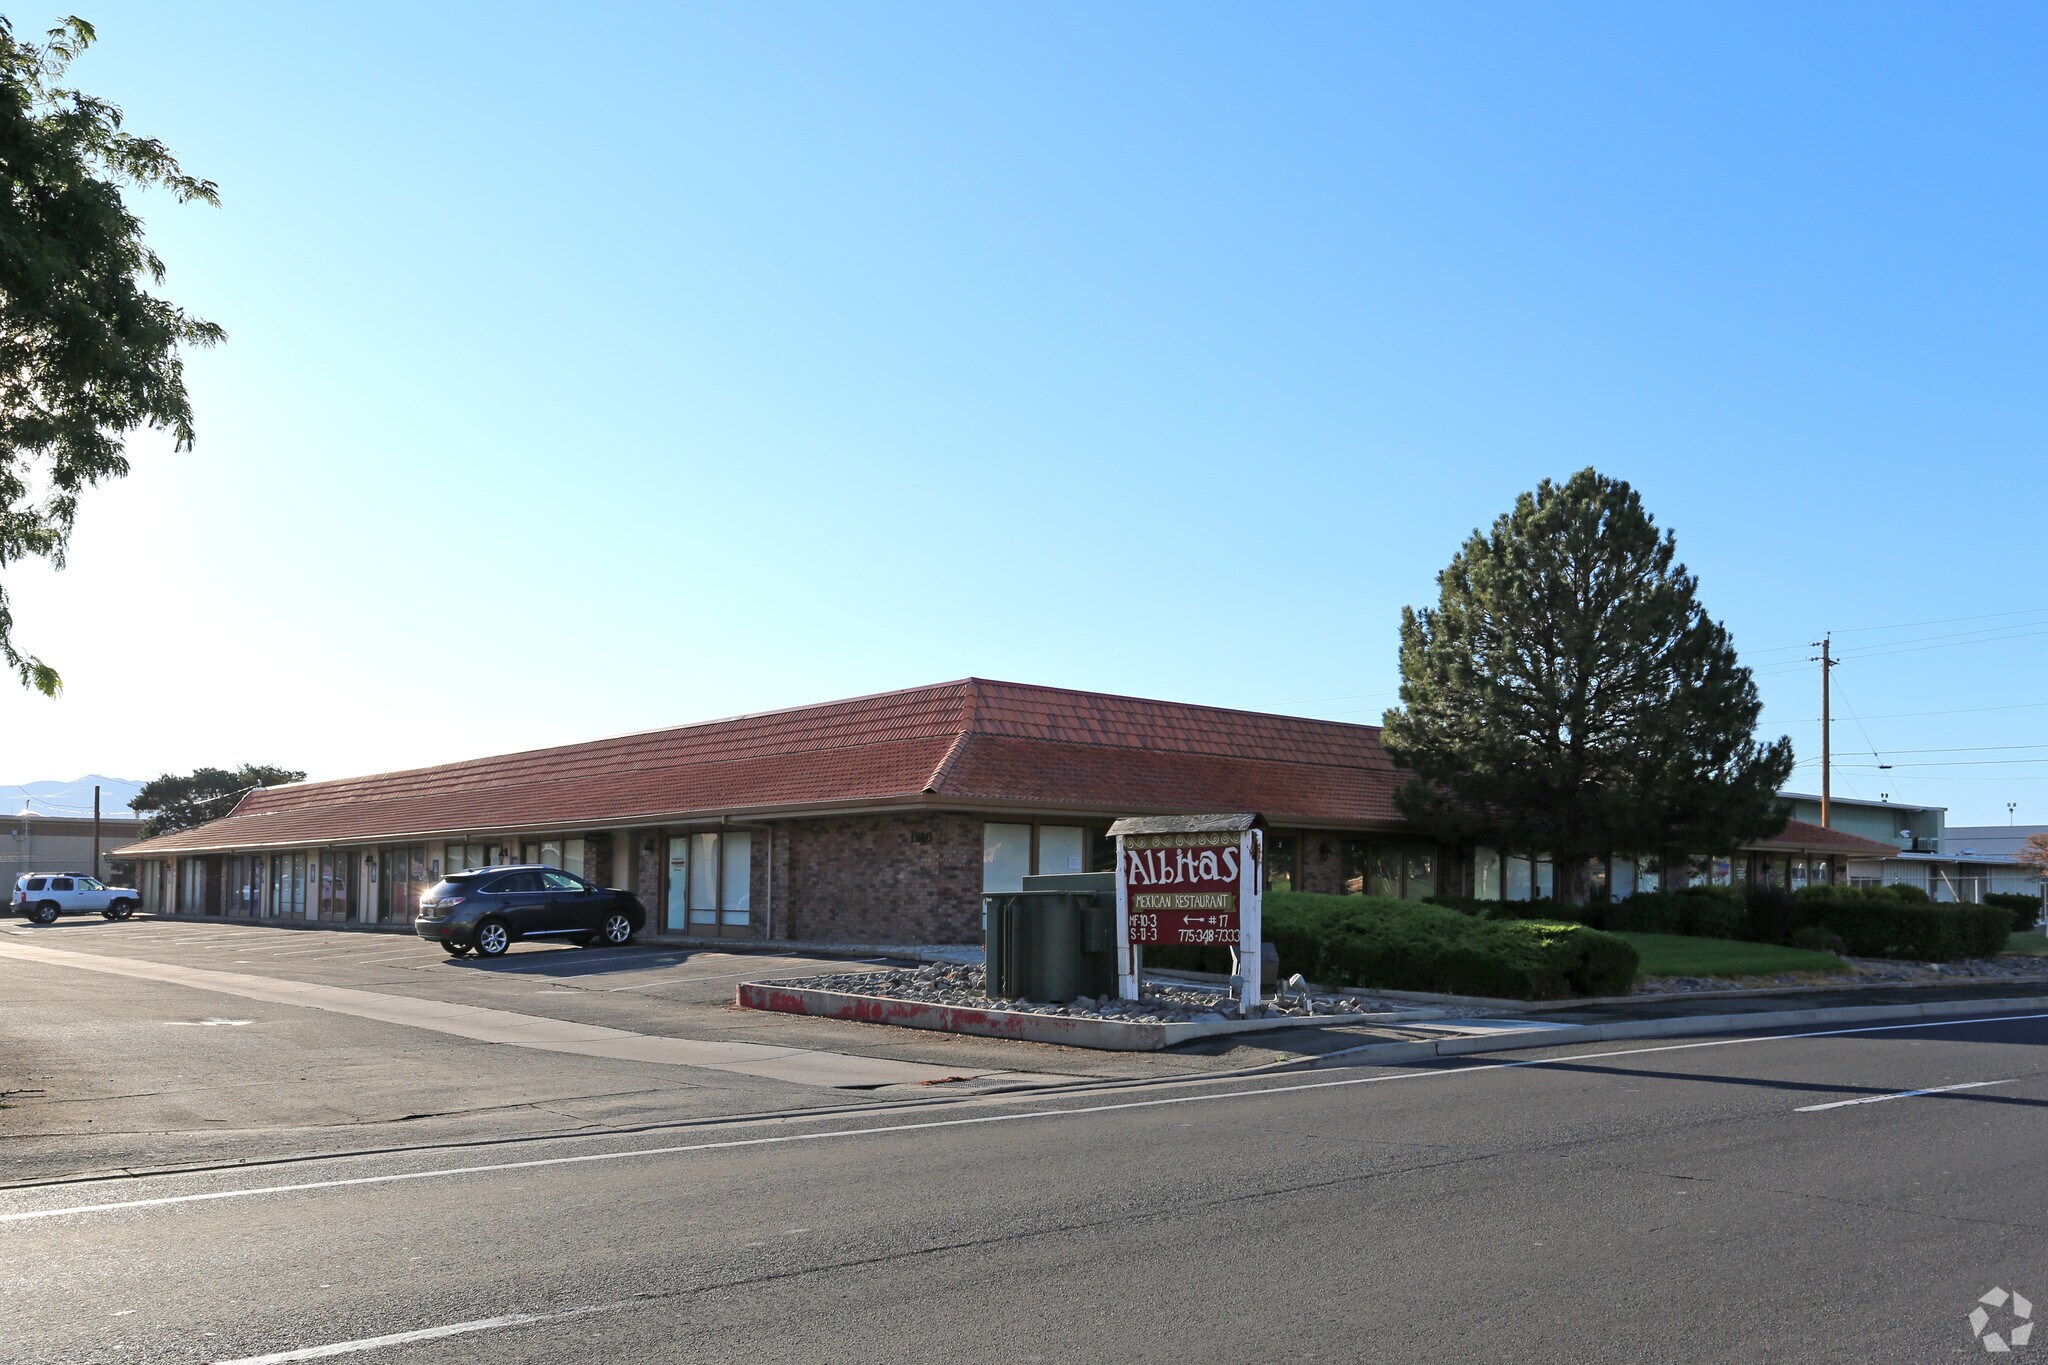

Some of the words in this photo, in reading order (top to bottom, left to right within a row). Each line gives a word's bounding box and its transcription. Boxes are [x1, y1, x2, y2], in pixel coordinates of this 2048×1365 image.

[1135, 895, 1171, 908] MEXICAN
[1175, 894, 1229, 908] RESTAURANT
[1178, 928, 1240, 942] 775-348-7333
